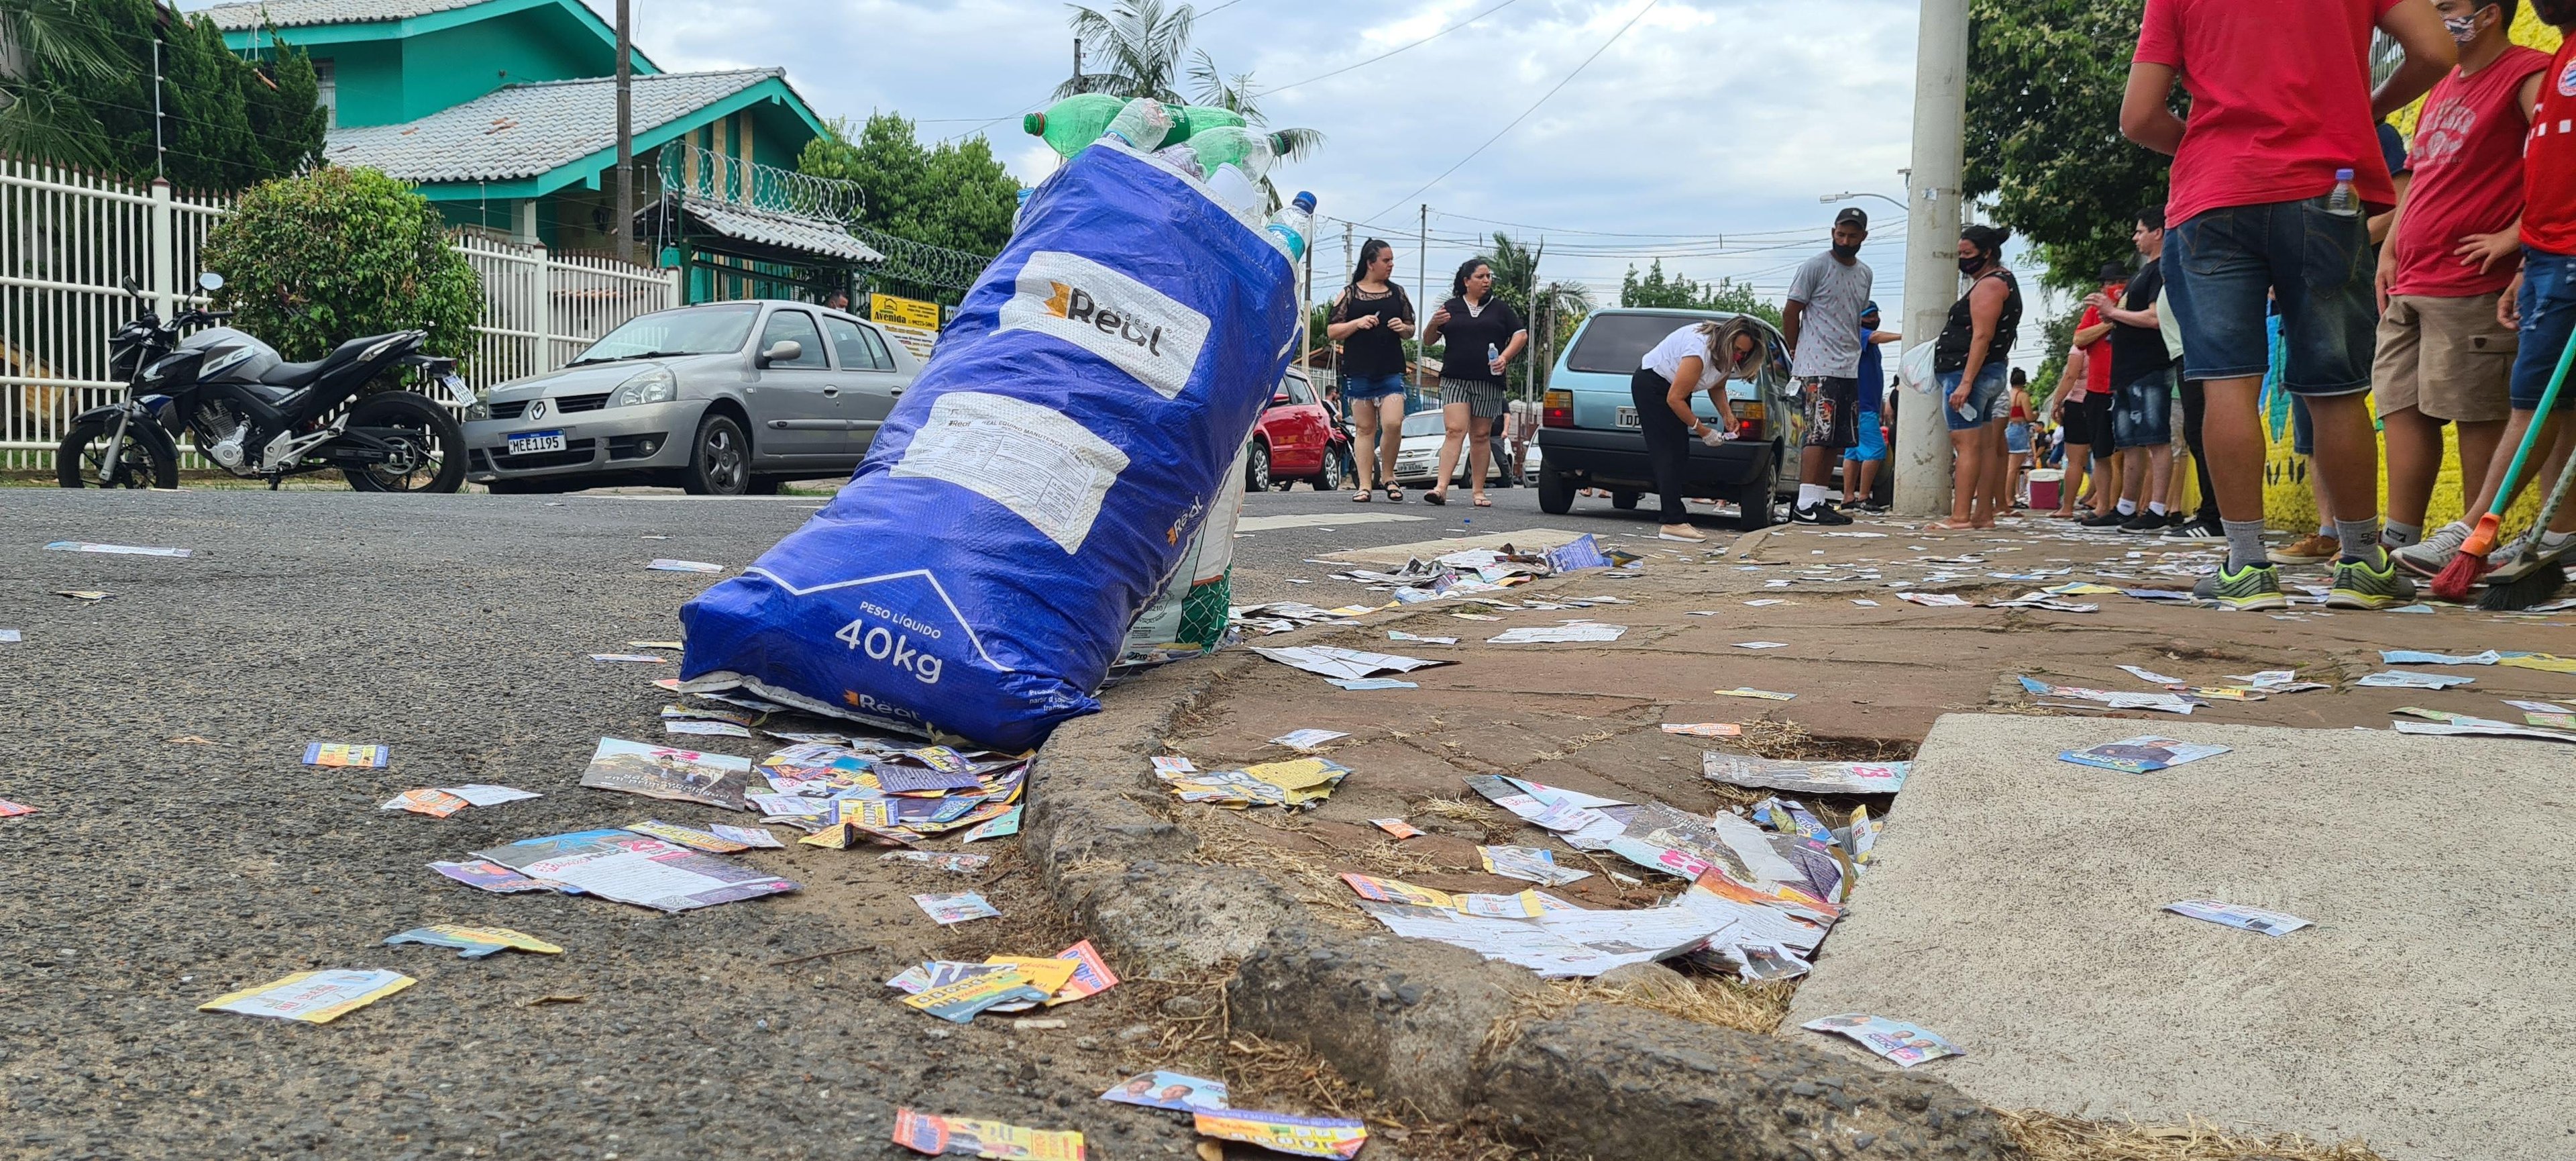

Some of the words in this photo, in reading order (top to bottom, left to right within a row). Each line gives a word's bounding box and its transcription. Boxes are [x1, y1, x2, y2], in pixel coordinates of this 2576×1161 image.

[874, 311, 907, 324] Avenida
[1068, 287, 1161, 357] Real
[998, 420, 1023, 432] EQUINO
[1024, 429, 1069, 450] MANUTENÇÃO
[1174, 494, 1203, 538] Real
[860, 601, 890, 619] PESO
[893, 614, 941, 639] LÍQUIDO
[835, 619, 943, 684] 40kg
